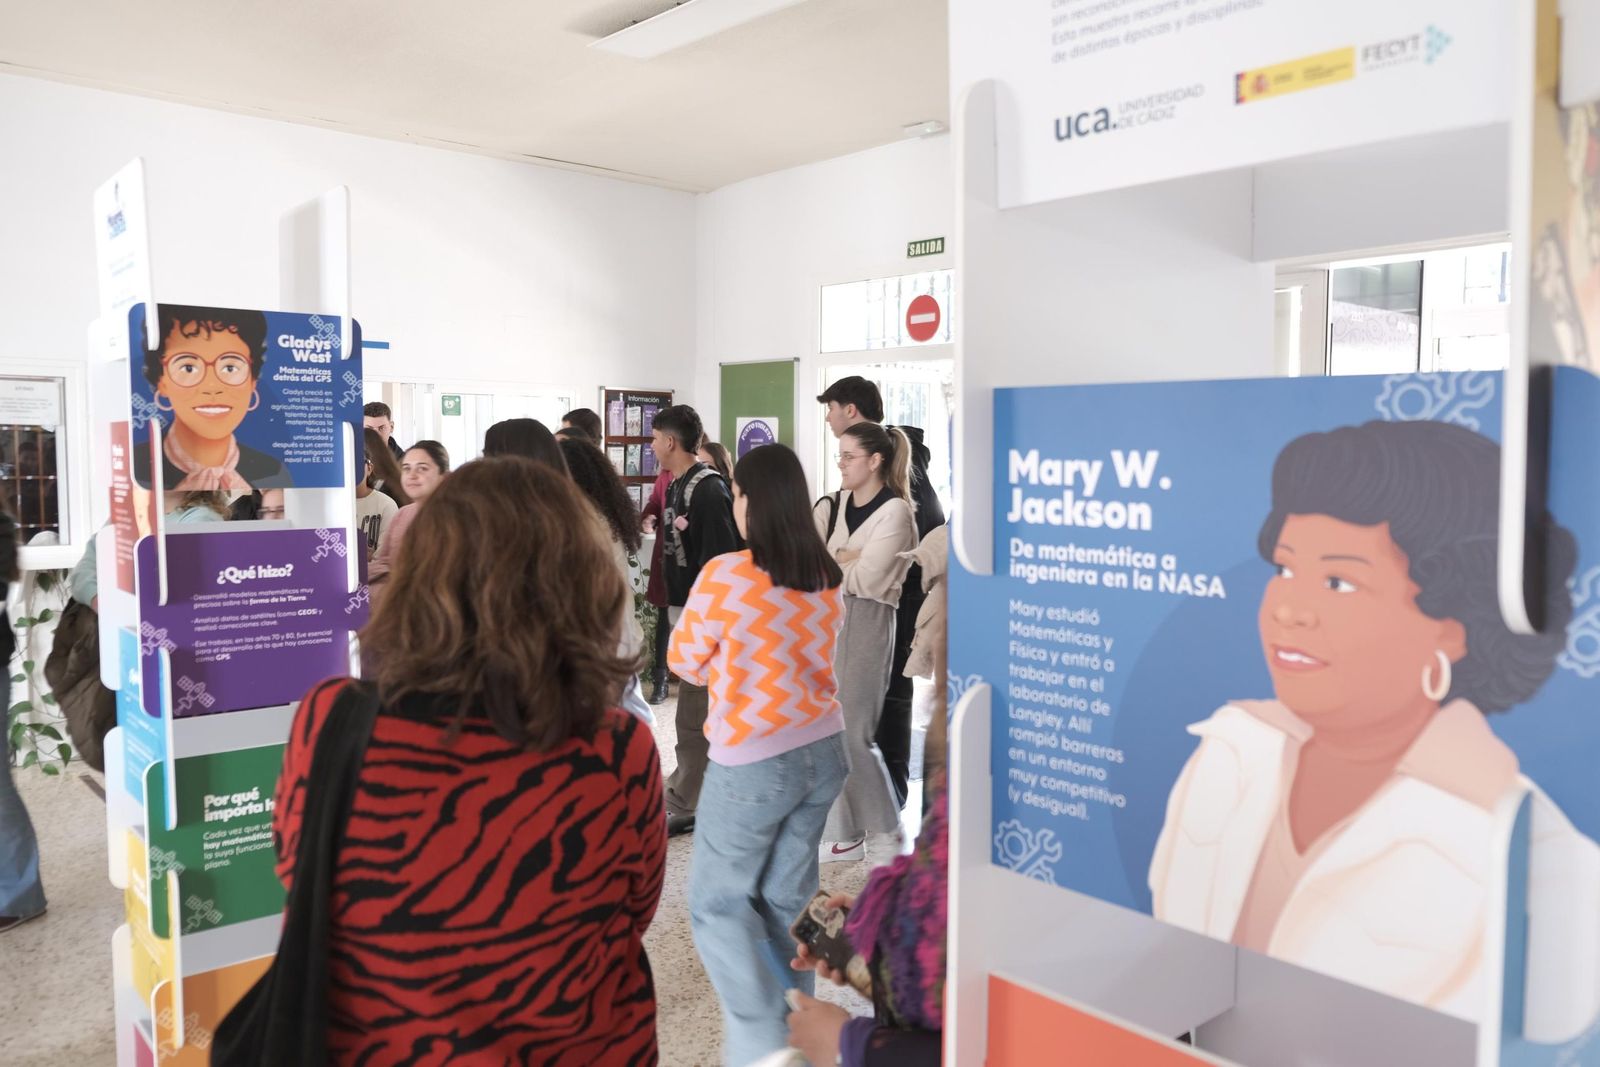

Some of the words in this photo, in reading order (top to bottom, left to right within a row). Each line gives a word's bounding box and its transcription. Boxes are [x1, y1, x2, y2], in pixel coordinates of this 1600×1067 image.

[1362, 33, 1421, 62] FECYT
[1118, 82, 1205, 115] UNIVERSIDAD
[909, 240, 942, 256] SALIDA
[277, 333, 332, 353] Gladys
[292, 349, 332, 363] West
[273, 373, 299, 382] detrás
[300, 374, 314, 382] del
[314, 375, 332, 383] GPS
[279, 366, 332, 376] Matemáticas
[628, 395, 660, 403] Información
[1008, 448, 1104, 497] Mary
[1110, 449, 1173, 490] W.
[1007, 487, 1153, 531] Jackson
[1010, 537, 1034, 558] De
[1037, 542, 1157, 570] matemática
[1161, 554, 1177, 571] a
[216, 565, 256, 584] ¿Qué
[258, 563, 294, 579] hizo?
[1010, 558, 1098, 585] ingeniera
[1102, 571, 1128, 589] en
[1132, 569, 1153, 592] la
[1158, 571, 1227, 599] NASA
[249, 598, 269, 606] forma
[1008, 598, 1045, 622] Mary
[1046, 606, 1100, 626] estudió
[1008, 619, 1101, 648] Matemáticas
[1102, 636, 1115, 653] y
[1008, 640, 1048, 661] Física
[1049, 650, 1060, 666] y
[1060, 652, 1101, 671] entró
[1103, 658, 1115, 673] a
[1008, 662, 1067, 687] trabajar
[1067, 674, 1088, 690] en
[1089, 676, 1104, 693] el
[1008, 682, 1088, 712] laboratorio
[1090, 698, 1111, 716] de
[1008, 726, 1059, 748] rompió
[1060, 735, 1125, 764] barreras
[1008, 747, 1027, 762] en
[1028, 751, 1047, 767] un
[1048, 756, 1107, 781] entorno
[203, 794, 231, 809] Por
[230, 786, 260, 806] qué
[1008, 767, 1039, 788] muy
[1040, 775, 1126, 809] competitivo
[204, 801, 264, 823] importa
